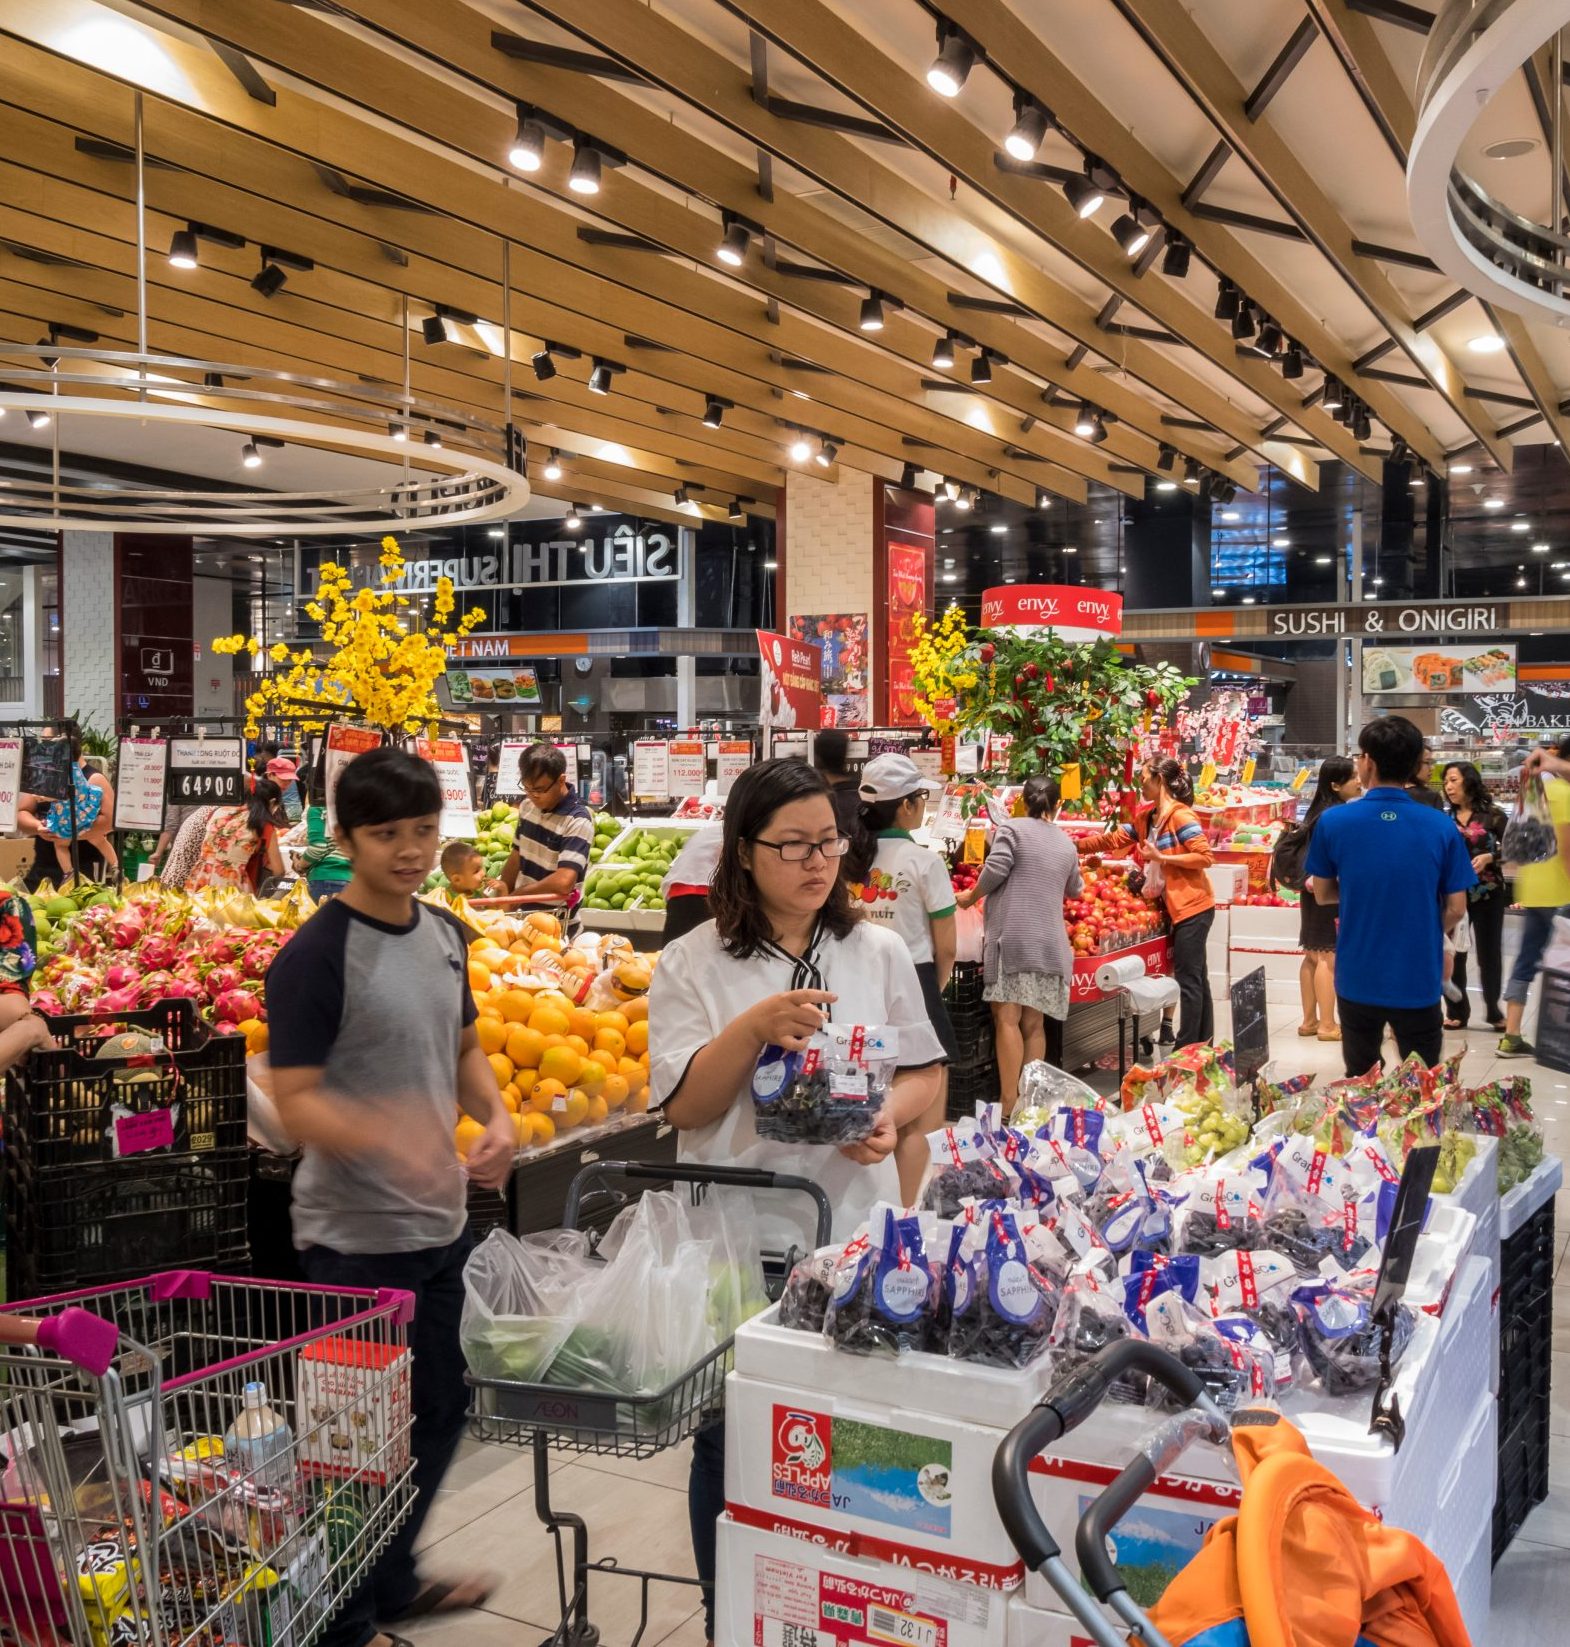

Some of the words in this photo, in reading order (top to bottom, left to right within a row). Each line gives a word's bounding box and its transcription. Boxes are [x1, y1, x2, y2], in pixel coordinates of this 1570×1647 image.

[1018, 598, 1060, 619] envy
[1077, 600, 1110, 623] envy
[1274, 612, 1345, 635] SUSHI
[1364, 610, 1384, 632] &
[1399, 607, 1497, 632] ONIGIRI
[471, 639, 510, 657] NAM
[147, 677, 169, 687] VND
[773, 1462, 831, 1491] APPLES
